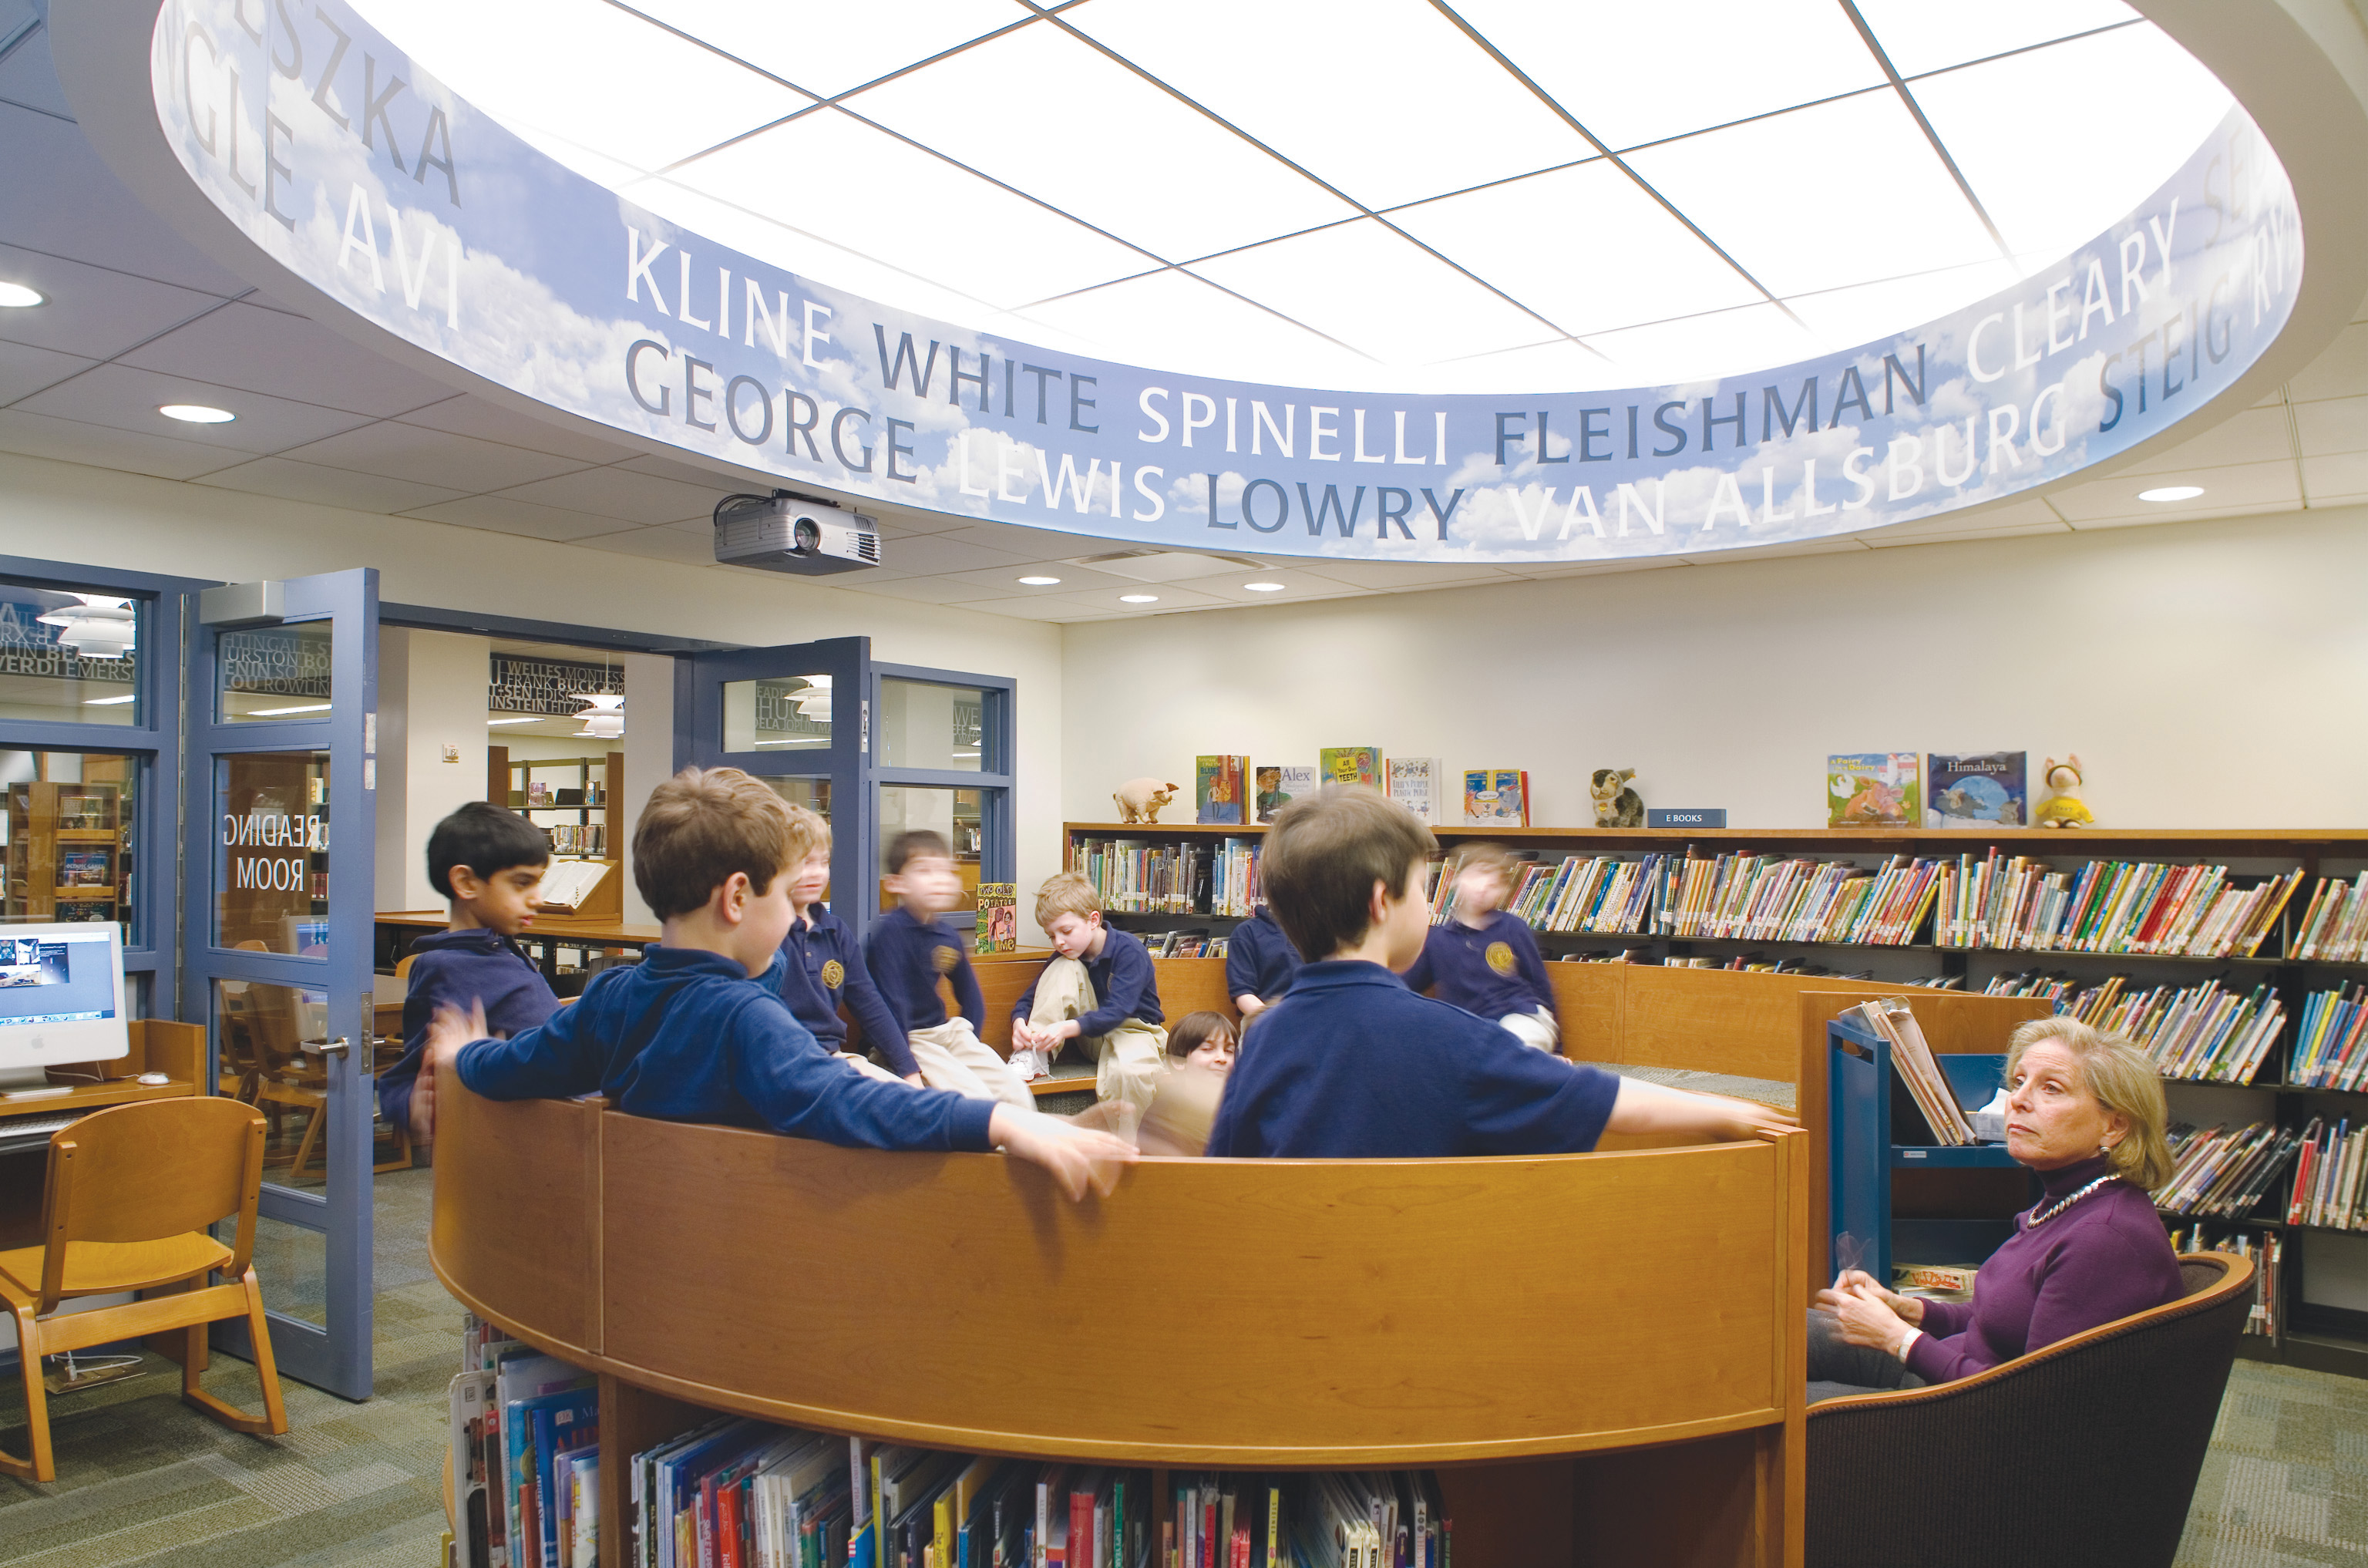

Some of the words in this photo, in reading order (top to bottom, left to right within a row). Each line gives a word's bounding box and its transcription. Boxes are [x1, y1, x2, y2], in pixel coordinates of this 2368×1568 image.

[626, 224, 833, 372] KLINE
[872, 322, 1100, 434] WHITE
[1137, 387, 1448, 466] SPINELLI
[1494, 343, 1928, 466] FLEISHMAN
[1966, 196, 2179, 383] CLEARY
[338, 182, 459, 331] AVI
[625, 339, 917, 484] GEORGE
[958, 432, 1166, 523] LEWIS
[1207, 473, 1465, 541] LOWRY
[1505, 480, 1665, 540] VAN
[1702, 383, 2067, 531] ALLSBURG
[2099, 275, 2231, 433] STEIG
[0, 641, 37, 659] LIN
[66, 661, 135, 681] EMERS
[507, 661, 561, 678] WELLES
[507, 673, 553, 690] FRANK
[557, 678, 597, 693] BUCK
[1281, 768, 1310, 781] Alex
[1339, 772, 1357, 782] TEETH
[1947, 760, 2007, 776] Himalaya
[703, 1519, 711, 1547] SIMPLE
